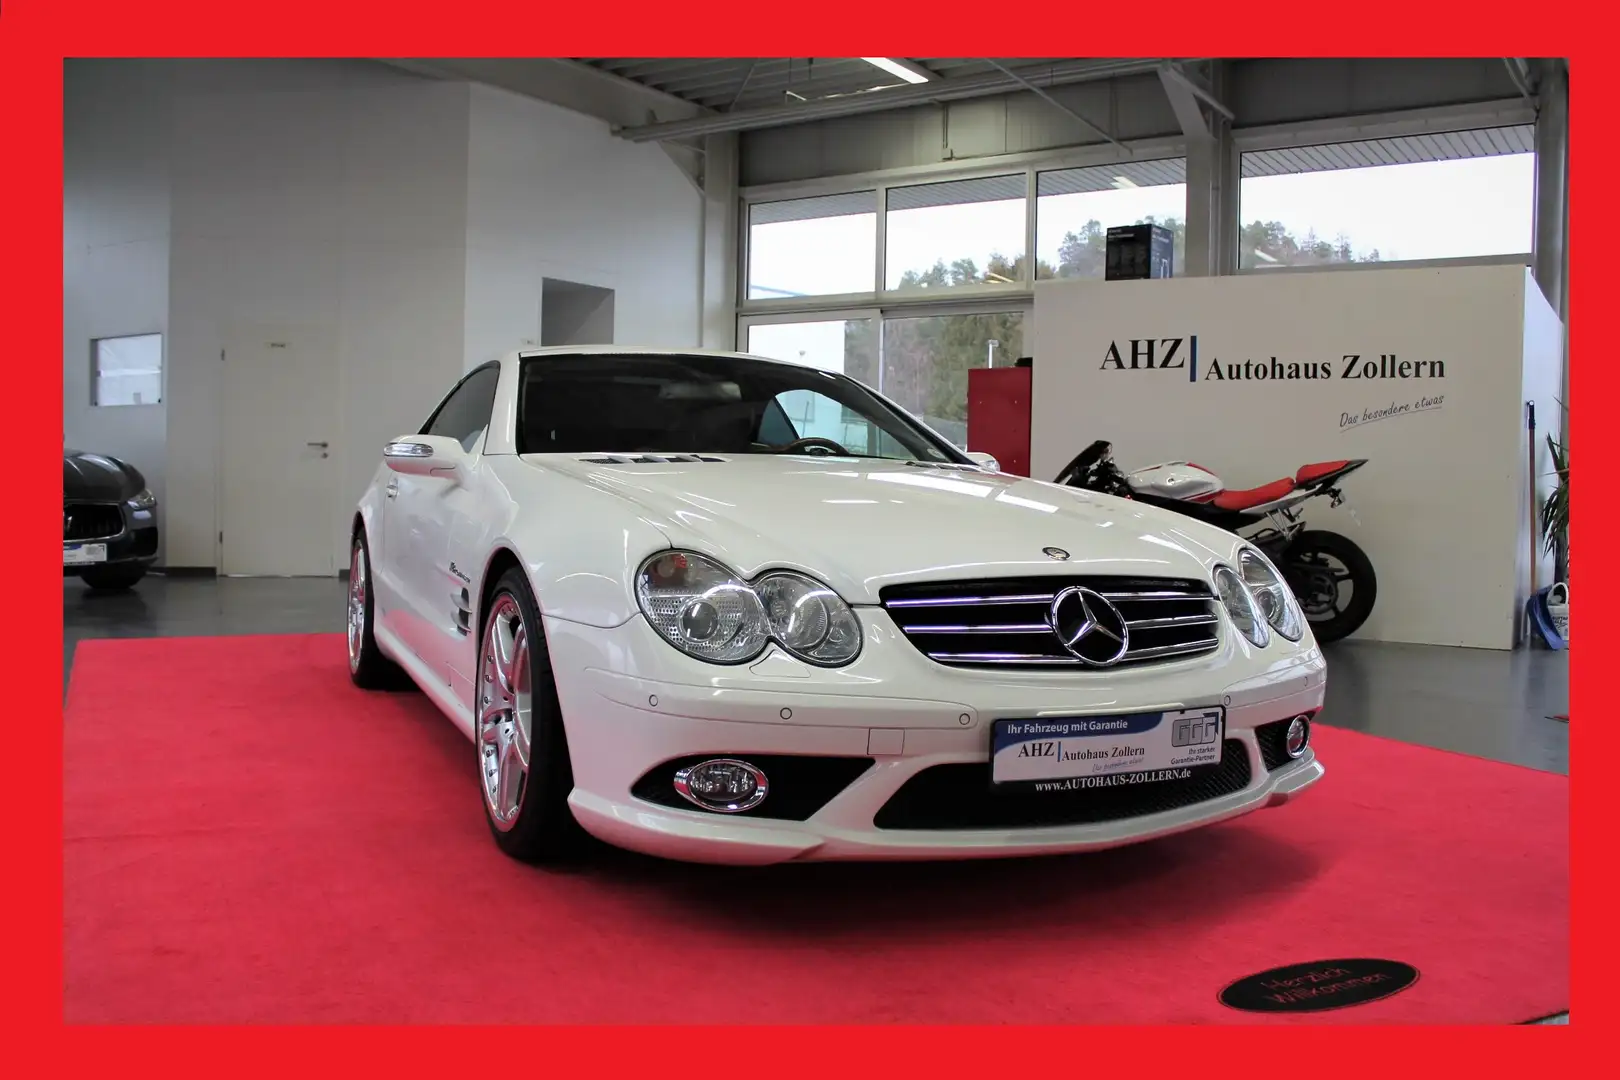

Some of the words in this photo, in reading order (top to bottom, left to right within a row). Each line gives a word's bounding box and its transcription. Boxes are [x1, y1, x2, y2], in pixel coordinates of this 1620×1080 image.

[1099, 337, 1185, 371] AHZ
[1205, 357, 1332, 381] Autohaus
[1341, 354, 1445, 379] Zollern
[1339, 411, 1359, 428] Das
[1362, 400, 1411, 422] besondere
[1414, 393, 1445, 410] etwas
[1007, 723, 1022, 735] Ihr
[1024, 721, 1069, 735] Fahrzeug
[1071, 720, 1087, 732] mit
[1089, 719, 1128, 730] Garantie
[1018, 742, 1055, 758] AHZ
[1062, 748, 1109, 762] Autohaus
[1111, 745, 1145, 758] Zollern
[1170, 755, 1216, 765] Garantie-Partner
[1197, 746, 1216, 754] starker
[1035, 768, 1192, 792] www.AUTOHAUS-ZOLLERN.de
[1260, 967, 1352, 990] Herzlich
[1261, 973, 1393, 1004] Willkommen
